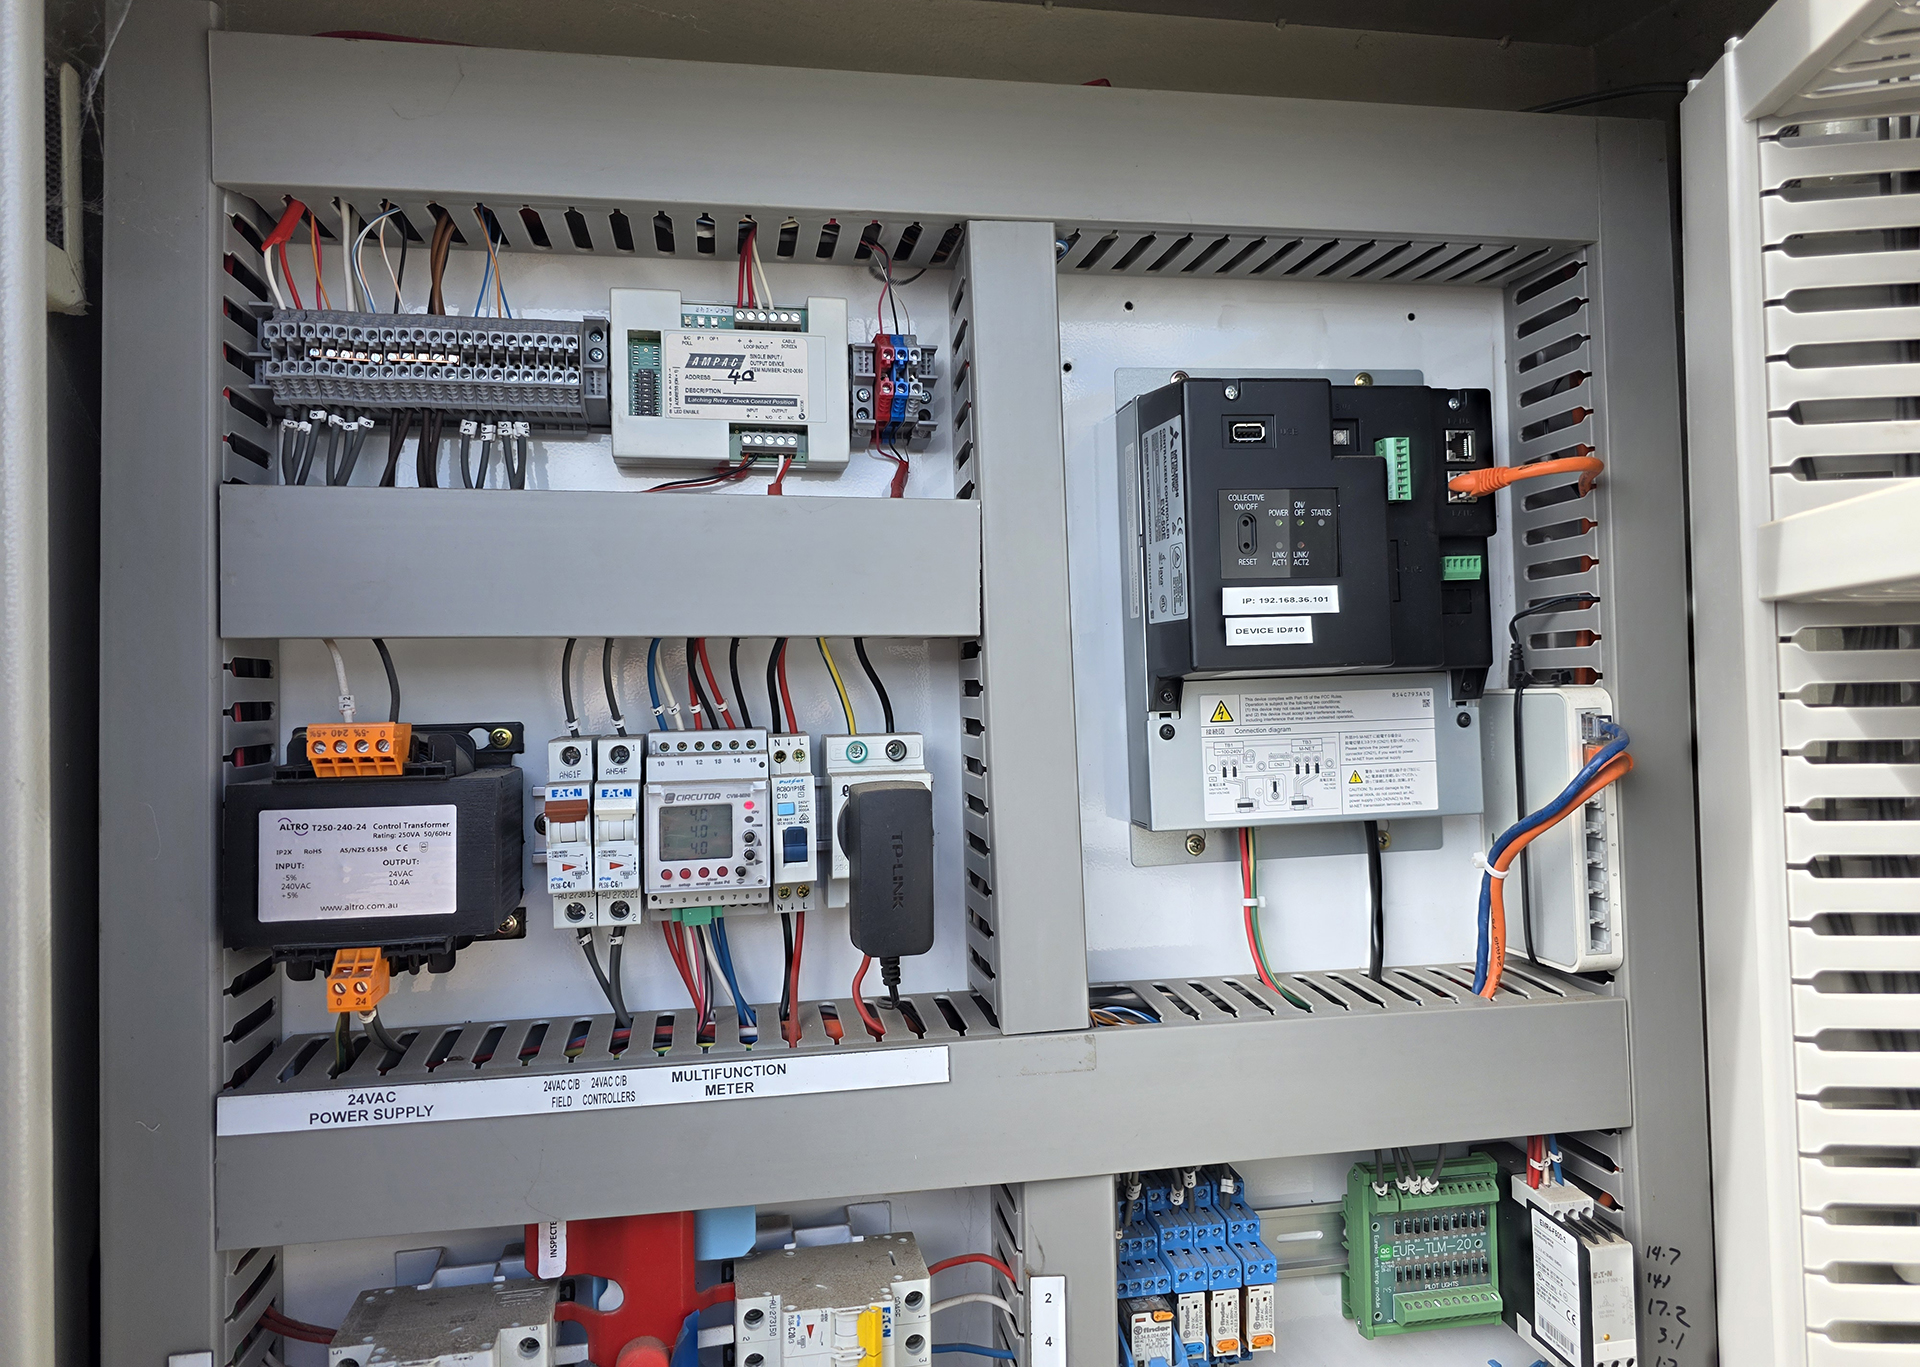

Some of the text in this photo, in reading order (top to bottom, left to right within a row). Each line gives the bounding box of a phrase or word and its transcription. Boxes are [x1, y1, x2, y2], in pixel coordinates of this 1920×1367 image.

[691, 357, 739, 367] AMPAC
[687, 397, 712, 405] Latching
[1272, 551, 1288, 559] LINK/
[1293, 551, 1310, 559] LINK/
[1238, 558, 1258, 566] RESET
[1259, 596, 1329, 604] 192.168.36.101
[1276, 626, 1305, 634] ID#10
[331, 729, 349, 738] 240
[774, 739, 780, 747] N
[559, 770, 581, 779] AN61F
[551, 788, 582, 798] EATON
[601, 788, 632, 798] EATON
[676, 793, 721, 801] CIRCUTOR
[690, 808, 708, 822] 4.0
[279, 823, 367, 832] ALTRO T250-240-24
[373, 821, 450, 830] Control Transformer
[373, 832, 397, 840] Rating:
[424, 830, 452, 838] 50/60Hz
[690, 825, 708, 838] 4.0
[340, 846, 365, 854] AS/NZS
[690, 841, 708, 855] 4.0
[275, 862, 305, 870] INPUT:
[382, 858, 420, 866] OUTPUT:
[891, 830, 904, 910] TP-LINK
[281, 882, 312, 890] 240VAC
[550, 881, 576, 889] PLS6-C4/1
[598, 880, 623, 888] PLS6-C6/1
[569, 890, 596, 899] 273019
[612, 890, 638, 898] 273021
[320, 902, 398, 912] www.altro.com.au
[589, 912, 594, 920] 2
[632, 913, 637, 922] 2
[336, 997, 367, 1006] 0 24
[671, 1063, 787, 1083] MULTIFUNCTION
[543, 1078, 580, 1092] 24VAC C/B
[591, 1075, 628, 1089] 24VAC C/B
[705, 1082, 755, 1096] METER
[347, 1091, 397, 1106] 24VAC
[551, 1095, 573, 1108] FIELD
[582, 1090, 636, 1106] CONTROLLERS
[309, 1105, 435, 1126] POWER SUPPLY
[1392, 1238, 1472, 1258] EUR-TLM-20
[1646, 1245, 1681, 1266] 14.7
[1044, 1292, 1053, 1304] 2
[1648, 1298, 1691, 1328] 17.2
[769, 1312, 777, 1337] 273150
[882, 1306, 891, 1338] EATON
[1044, 1336, 1053, 1347] 4
[1657, 1327, 1685, 1350] 3.1
